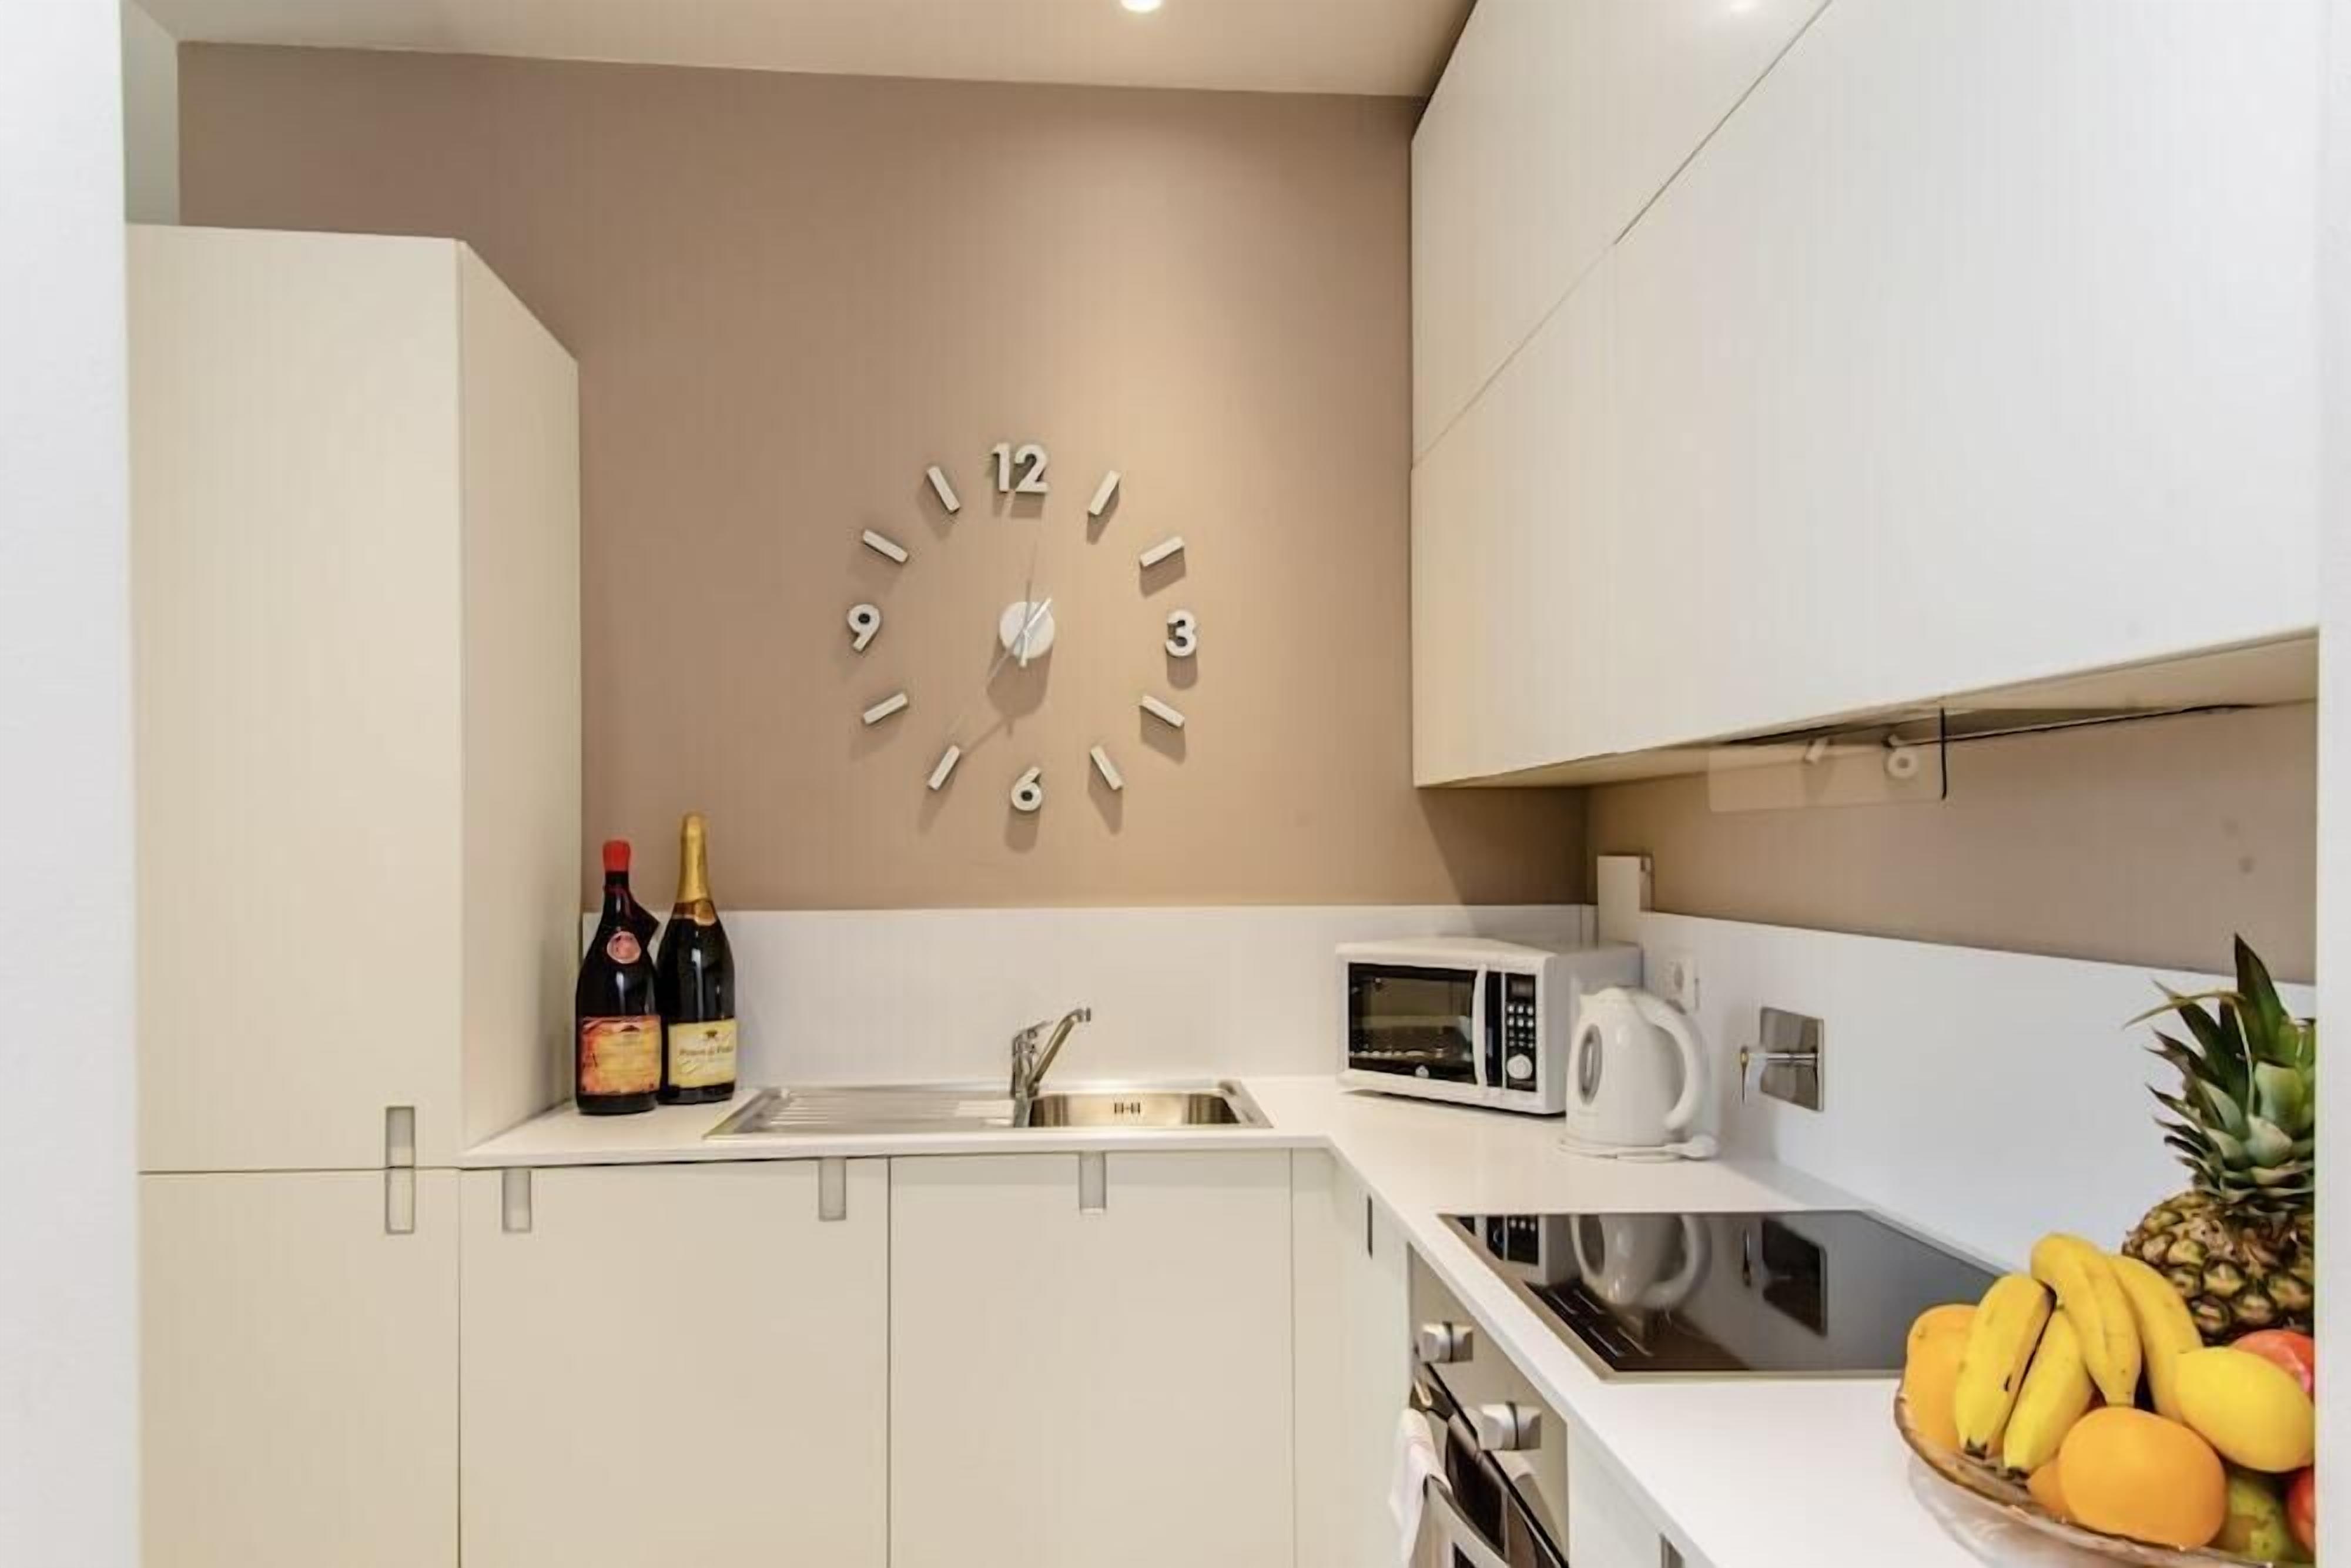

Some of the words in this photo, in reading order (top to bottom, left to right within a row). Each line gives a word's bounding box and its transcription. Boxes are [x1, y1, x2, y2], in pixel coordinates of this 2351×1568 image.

[991, 443, 1049, 494] 12
[846, 603, 881, 652] 9
[1165, 609, 1197, 657] 3
[1010, 766, 1043, 812] 6
